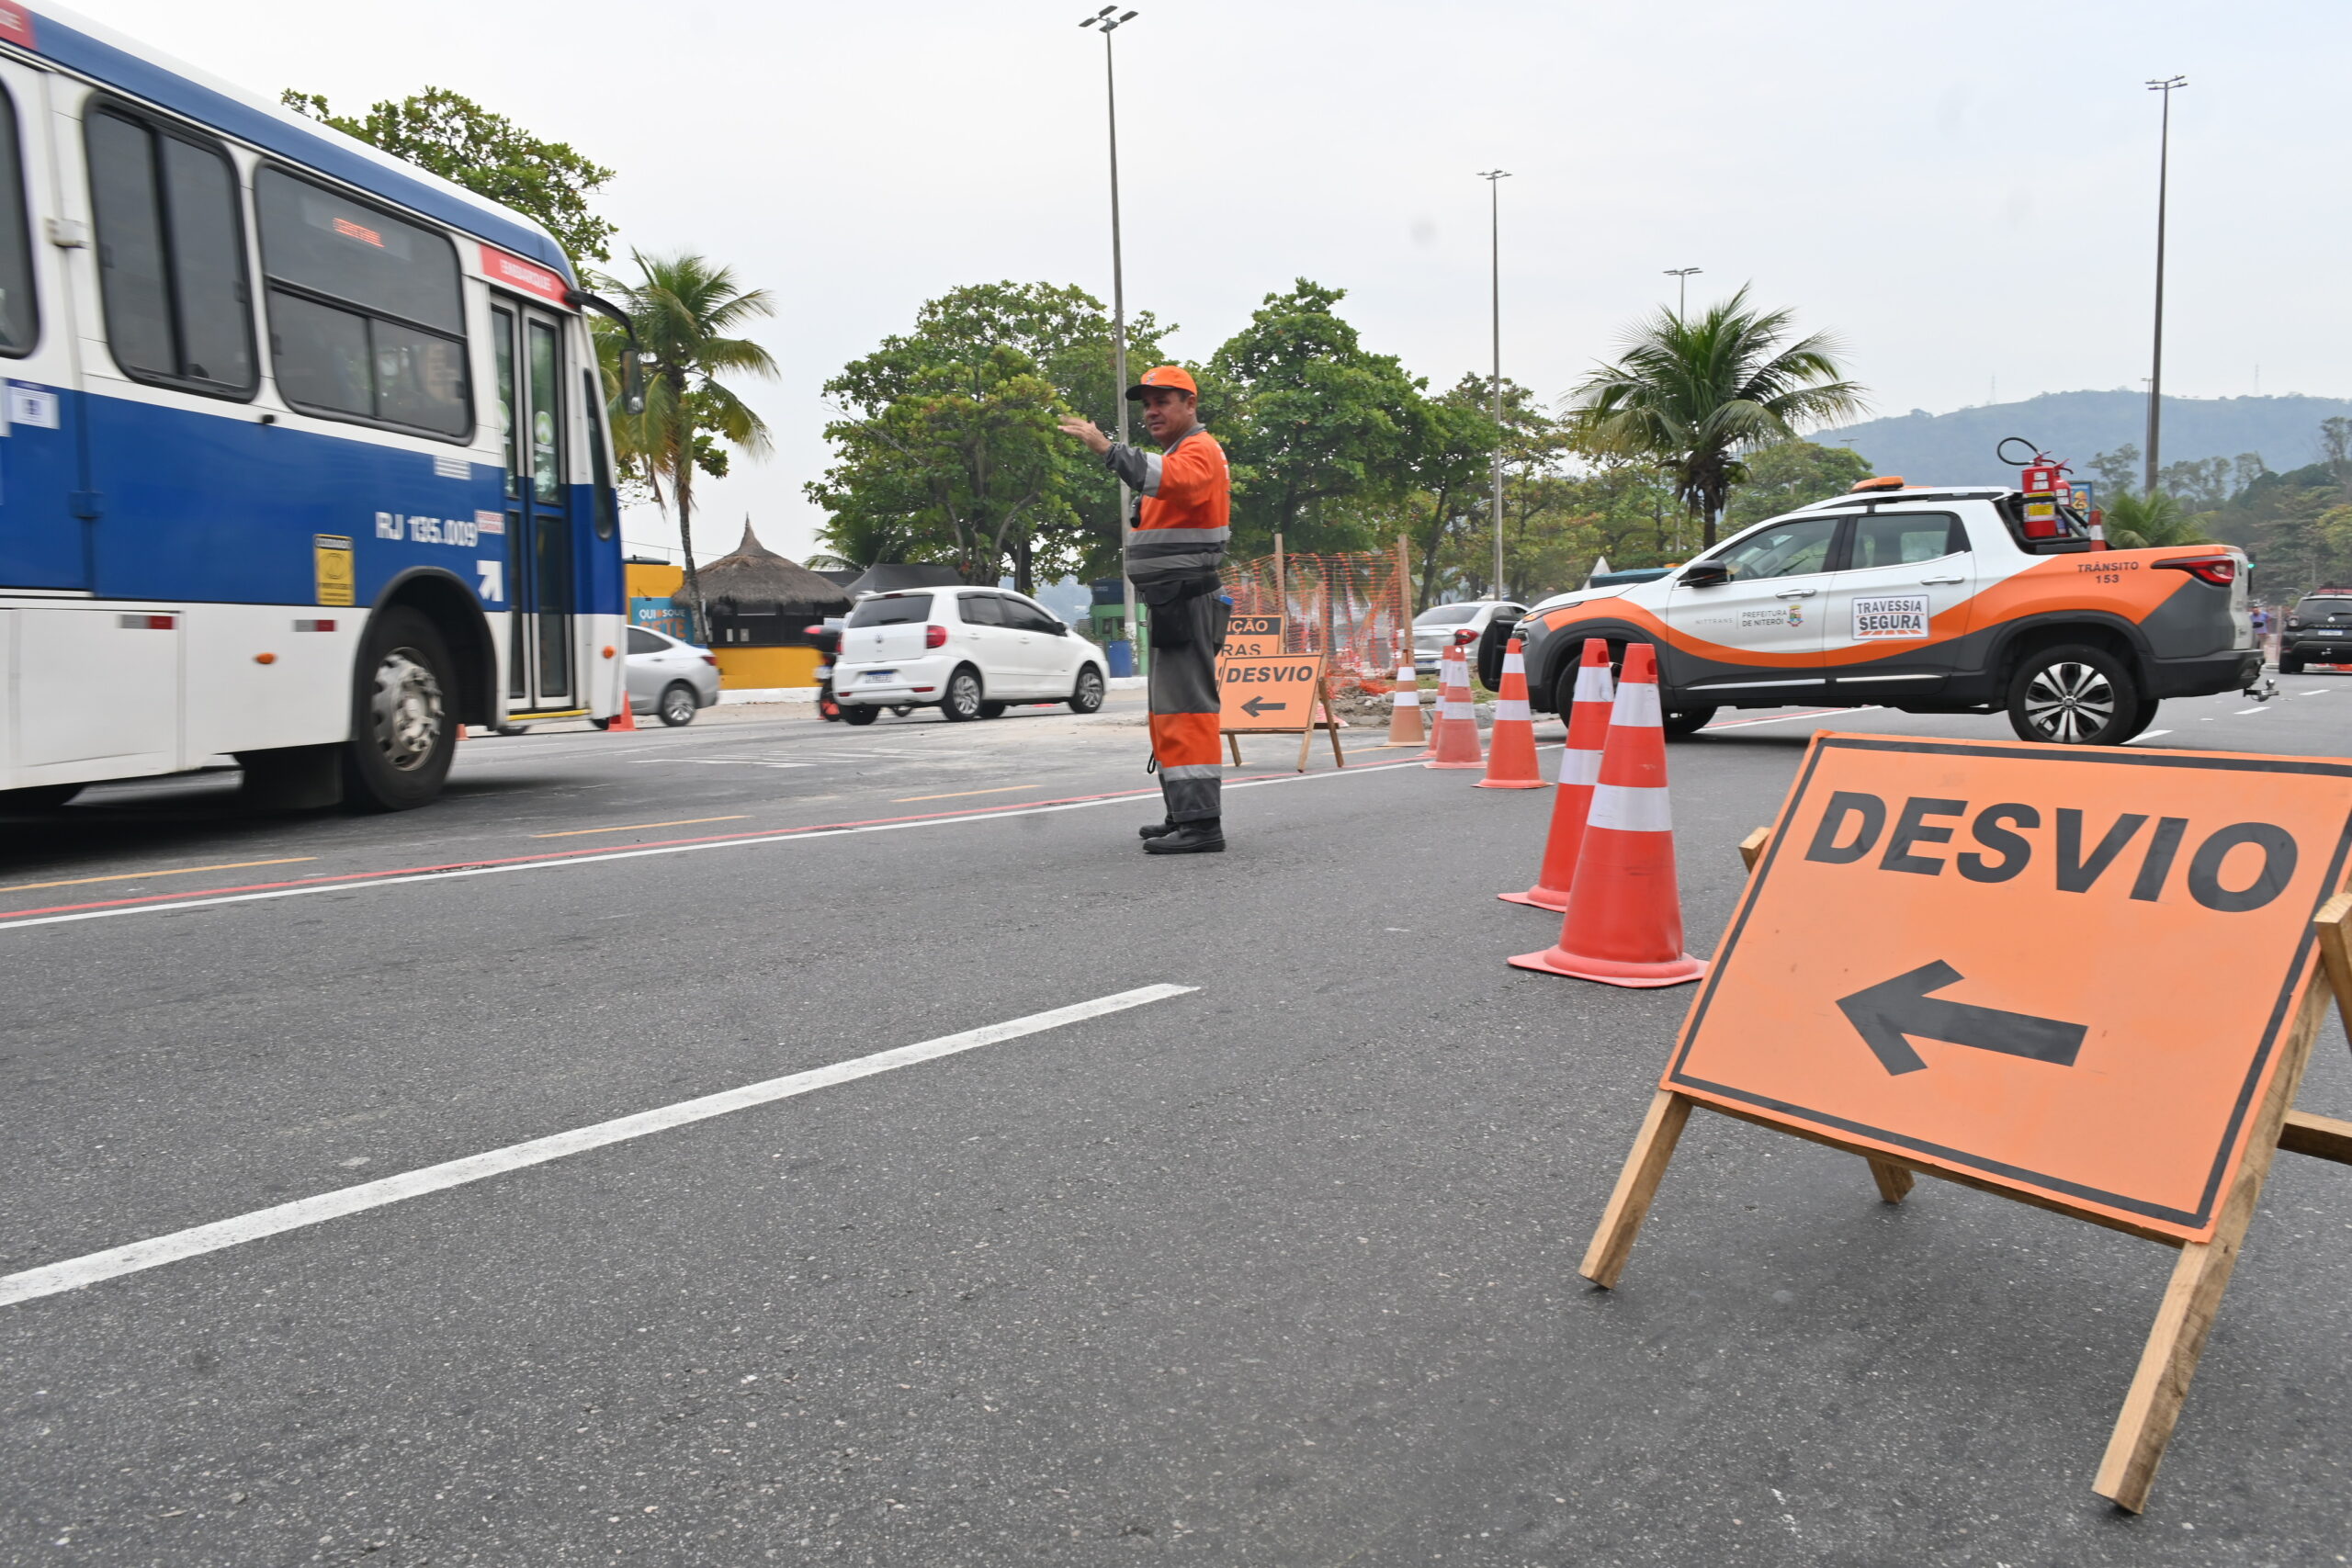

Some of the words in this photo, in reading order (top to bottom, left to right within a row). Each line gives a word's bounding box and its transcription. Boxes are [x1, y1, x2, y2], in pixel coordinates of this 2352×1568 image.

[375, 511, 404, 540] RJ
[408, 515, 479, 547] 135.009
[2077, 561, 2139, 573] TRÂNSITO
[2096, 574, 2120, 584] 153
[1742, 609, 1787, 618] PREFEITURA
[1857, 600, 1922, 615] TRAVESSIA
[1859, 615, 1921, 631] SEGURA
[1226, 665, 1314, 683] DESVIO
[1804, 790, 2299, 913] DESVIO
